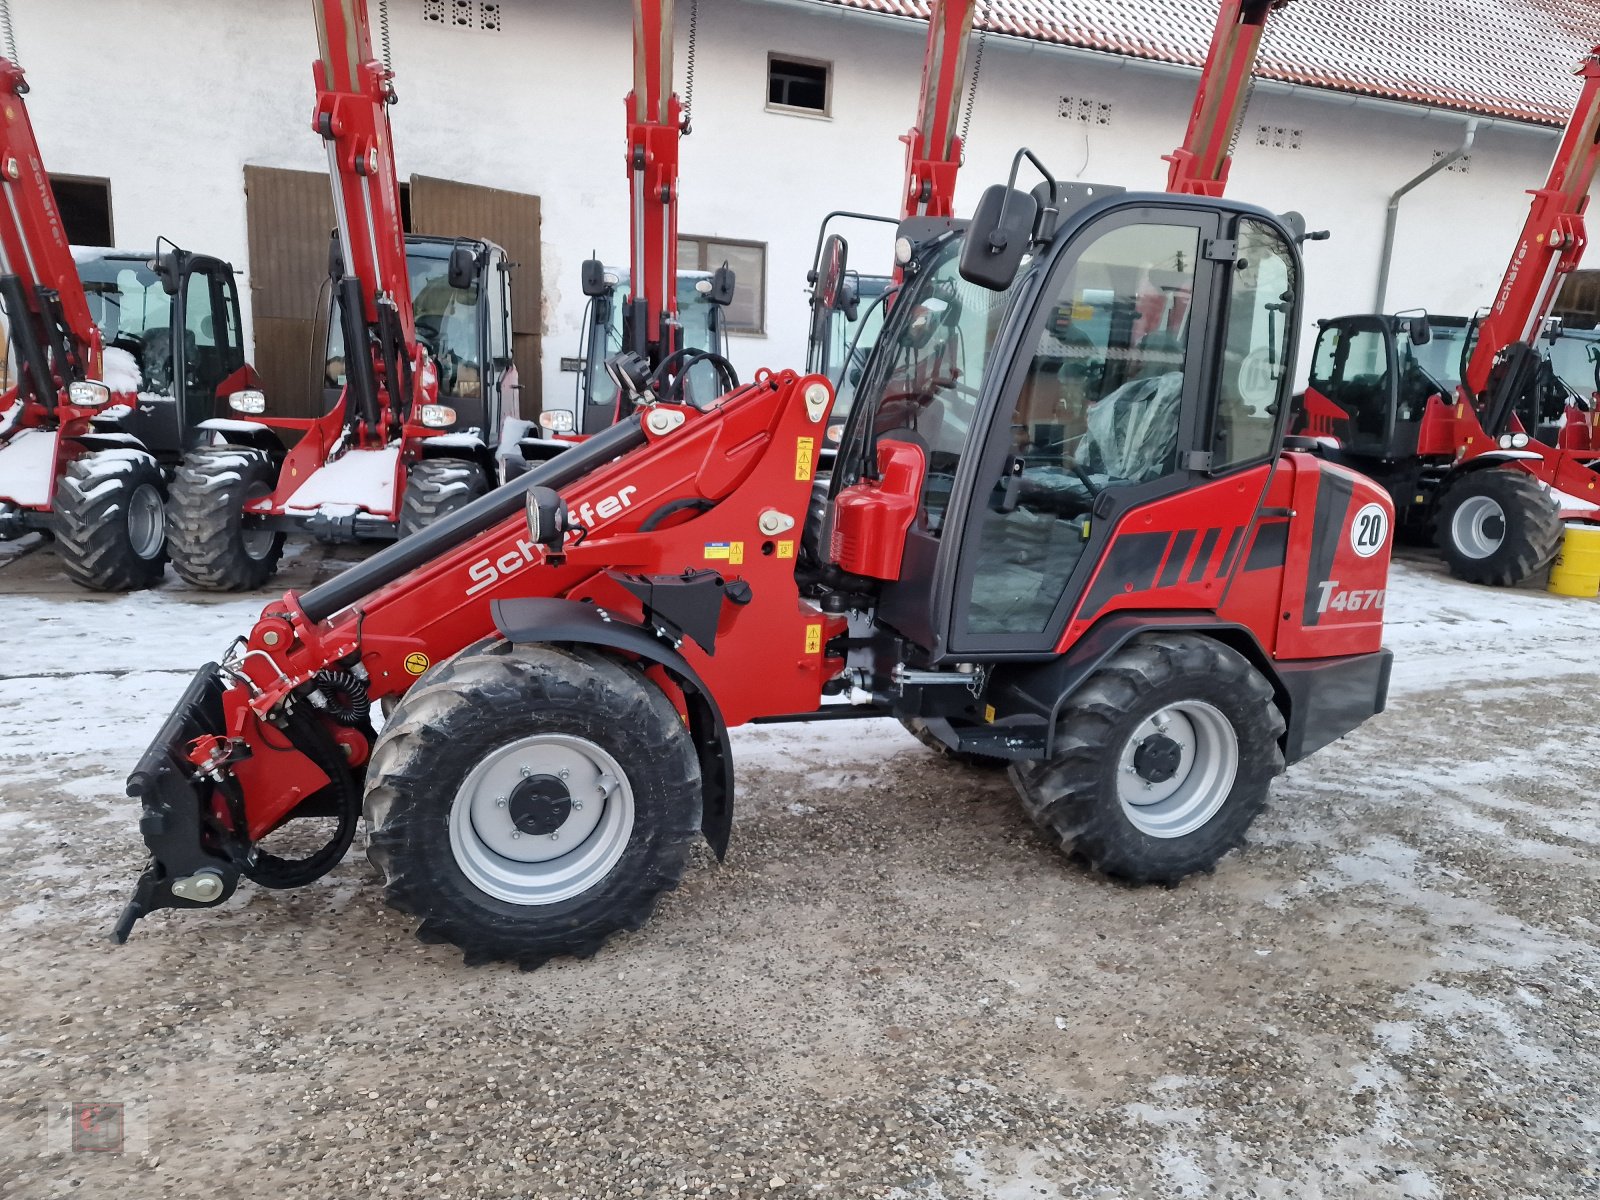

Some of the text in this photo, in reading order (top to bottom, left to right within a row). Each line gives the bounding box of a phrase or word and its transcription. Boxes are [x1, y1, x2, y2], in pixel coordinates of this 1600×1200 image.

[1496, 240, 1528, 315] Schäffer
[465, 485, 637, 596] Schffer
[1357, 514, 1382, 546] 20
